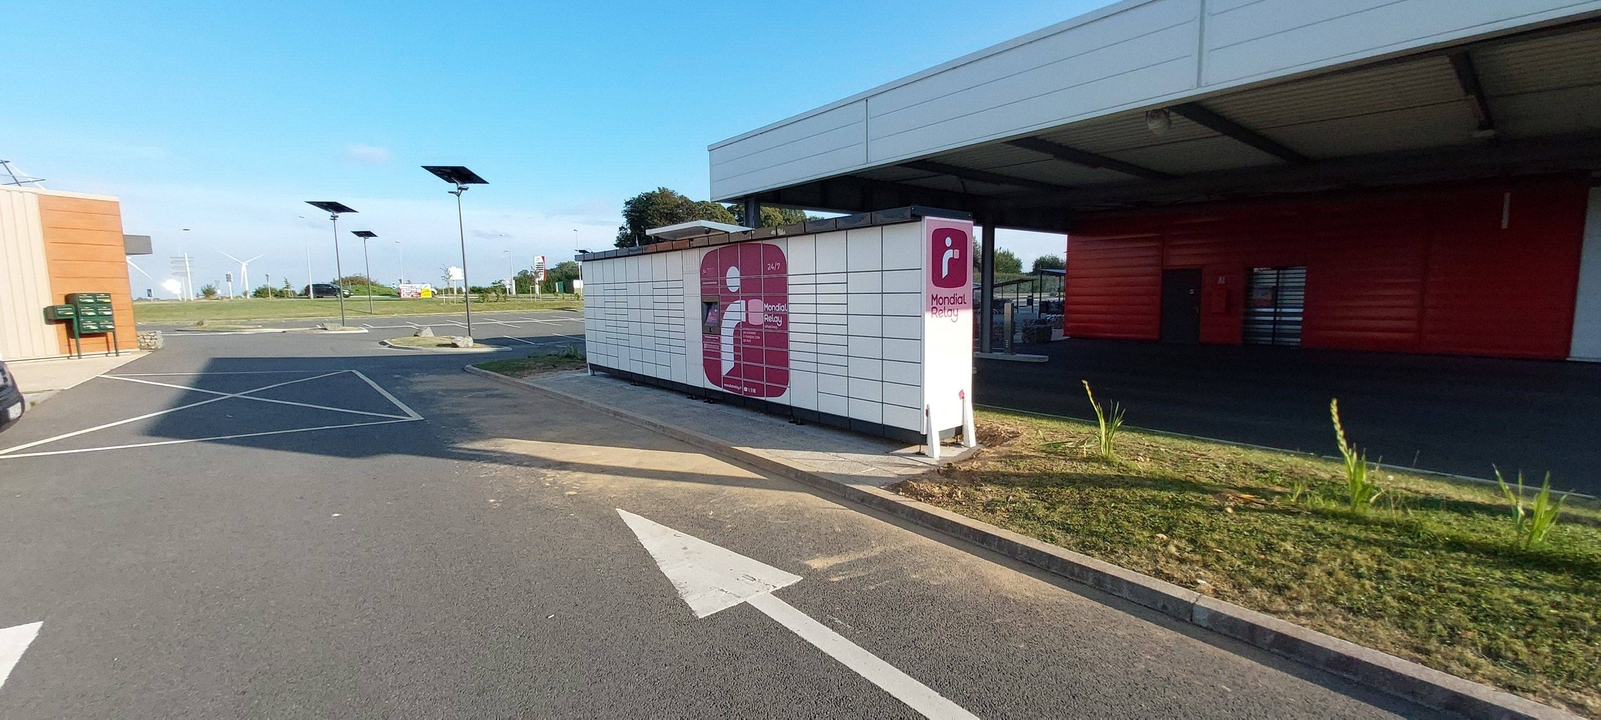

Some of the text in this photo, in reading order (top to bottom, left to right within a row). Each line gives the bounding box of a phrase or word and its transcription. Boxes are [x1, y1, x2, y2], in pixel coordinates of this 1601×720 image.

[767, 262, 780, 271] 24/7
[931, 293, 966, 305] Mondial
[764, 303, 788, 312] Mondial
[764, 314, 782, 326] Relay
[931, 306, 958, 323] Relay
